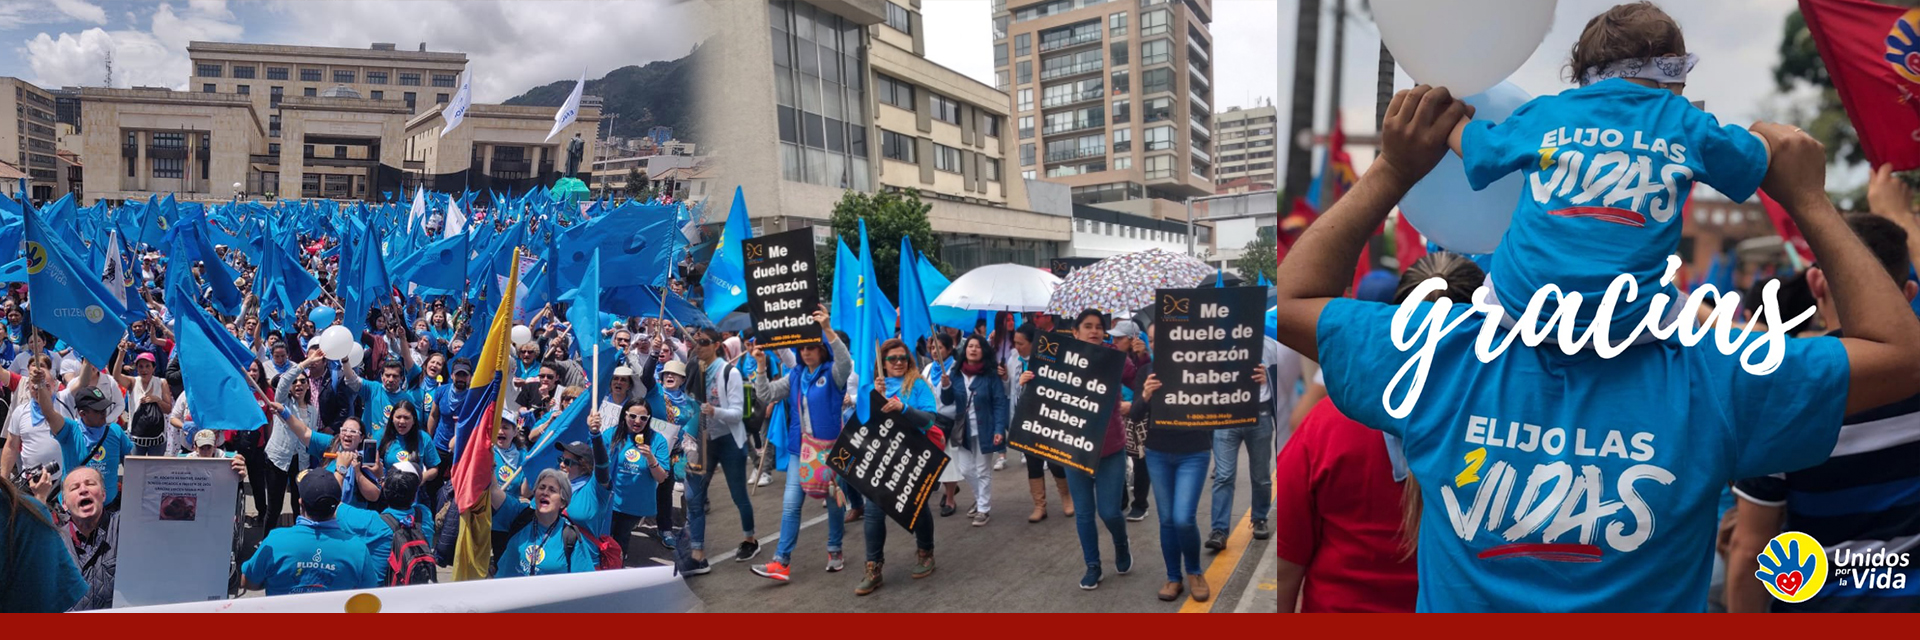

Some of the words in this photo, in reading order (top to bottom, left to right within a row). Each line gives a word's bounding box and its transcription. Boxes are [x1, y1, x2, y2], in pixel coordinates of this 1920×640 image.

[1540, 126, 1624, 148] ELIJO
[1632, 130, 1686, 164] LAS
[1529, 150, 1694, 223] VIDAS
[768, 245, 789, 259] Me
[753, 263, 788, 280] duele
[791, 260, 809, 274] de
[756, 278, 808, 297] corazón
[764, 298, 803, 313] haber
[1200, 303, 1230, 319] Me
[1169, 325, 1226, 341] duele
[1231, 324, 1254, 339] de
[1064, 350, 1089, 369] Me
[1171, 345, 1249, 363] corazón
[1038, 364, 1082, 387] duele
[1086, 378, 1107, 395] de
[1182, 369, 1240, 384] haber
[1036, 384, 1100, 413] corazón
[1164, 389, 1252, 405] abortado
[1039, 403, 1087, 429] haber
[850, 425, 869, 450] Me
[855, 438, 881, 479] duele
[878, 418, 894, 438] de
[1021, 419, 1095, 452] abortado
[1465, 415, 1566, 456] ELIJO
[1575, 428, 1656, 461] LAS
[870, 431, 906, 488] corazón
[884, 448, 913, 492] haber
[1455, 447, 1487, 488] 2
[894, 449, 931, 514] abortado
[1440, 460, 1677, 552] VIDAS
[320, 563, 336, 571] LAS
